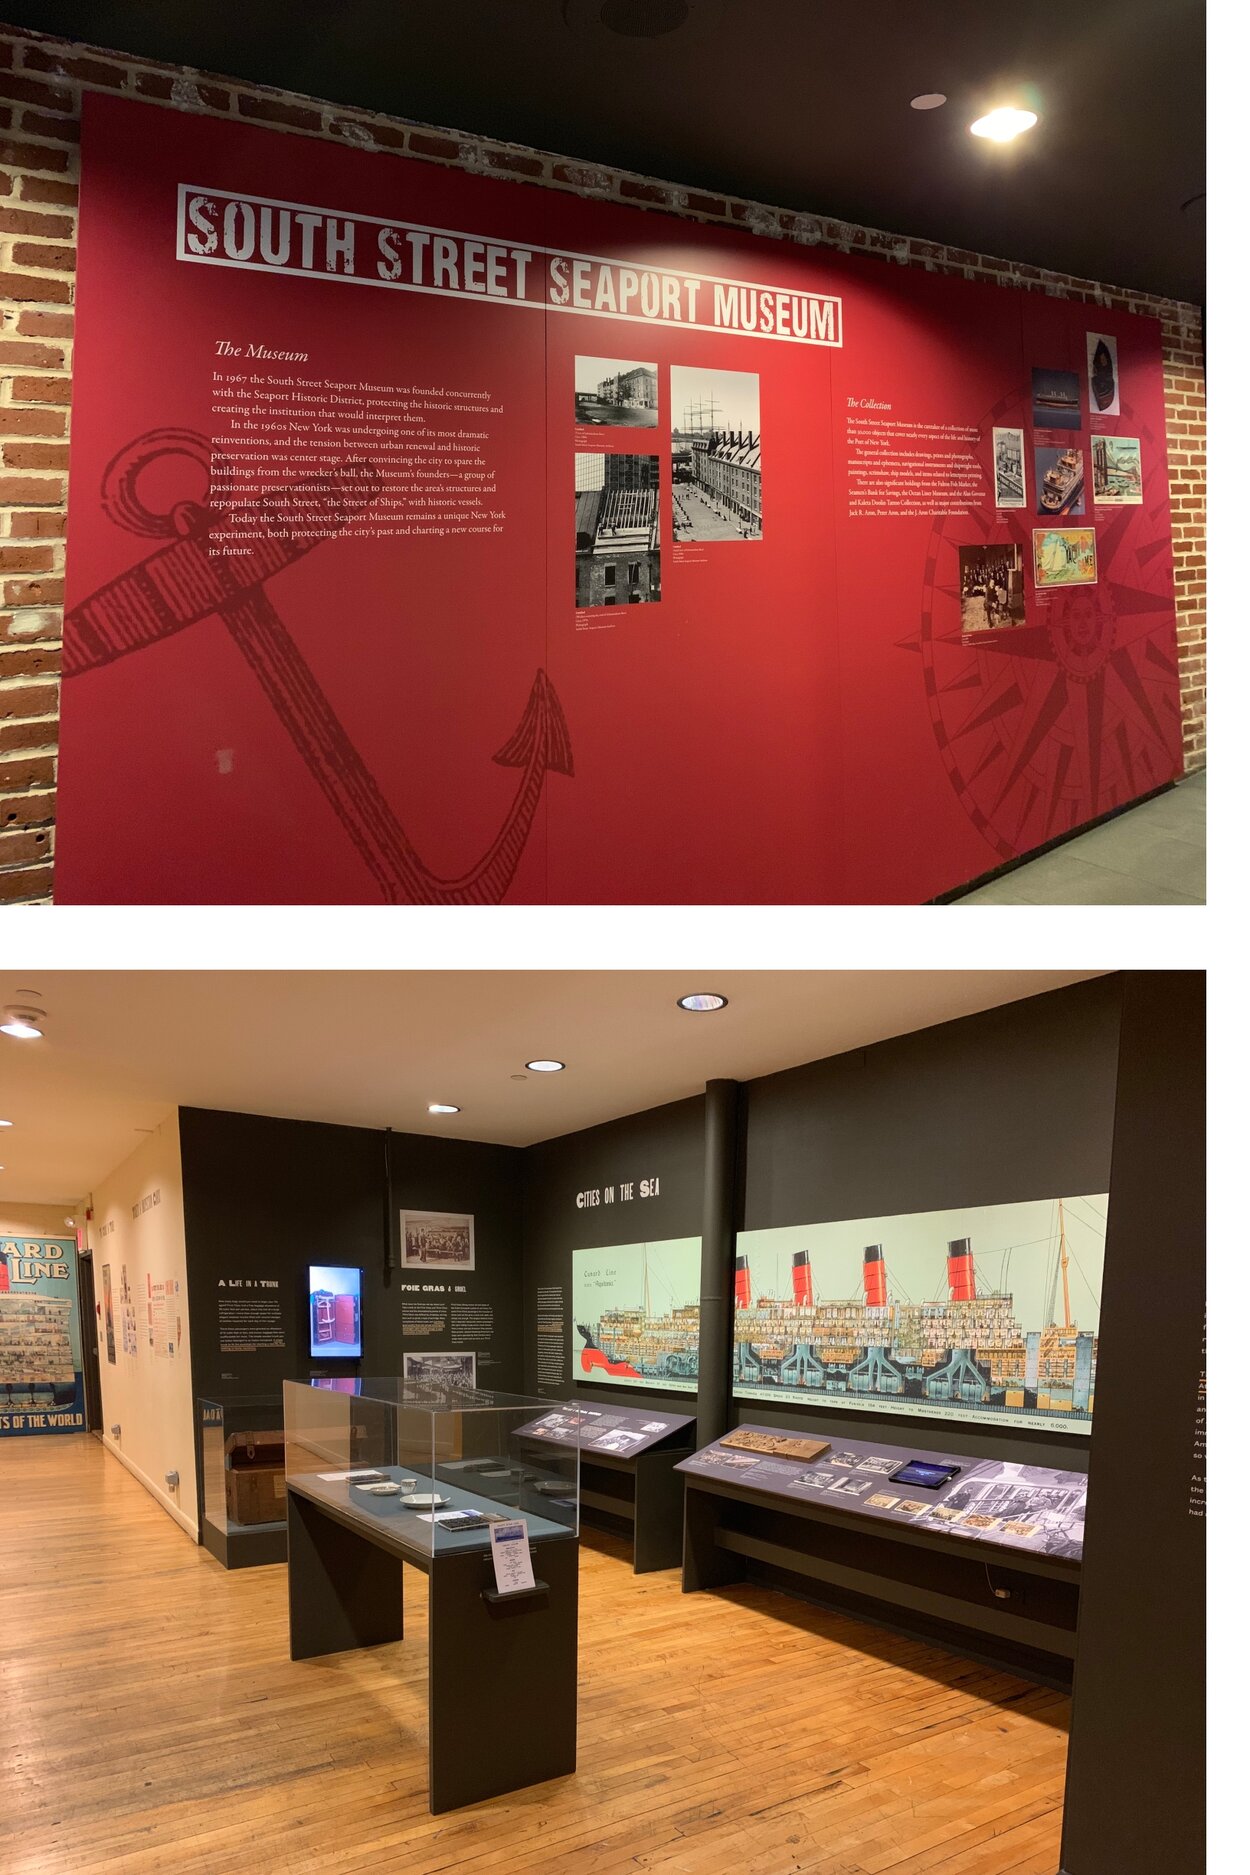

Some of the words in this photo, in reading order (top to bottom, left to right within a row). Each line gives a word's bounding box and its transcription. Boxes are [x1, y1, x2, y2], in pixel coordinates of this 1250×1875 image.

[187, 196, 355, 275] SOUTH
[377, 227, 532, 299] STREET
[549, 257, 701, 323] SEAPORT
[713, 284, 835, 341] MUSEUM
[215, 340, 241, 358] The
[246, 343, 309, 362] Museum
[213, 371, 222, 381] In
[226, 372, 247, 385] 1967
[250, 374, 264, 384] the
[267, 375, 294, 386] South
[297, 377, 322, 387] Street
[324, 379, 356, 392] Seaport
[359, 381, 394, 392] Museum
[412, 385, 444, 395] founded
[446, 388, 491, 400] concurrently
[213, 387, 233, 398] with
[237, 388, 251, 398] the
[254, 390, 288, 403] Seaport
[292, 392, 327, 403] Historic
[367, 396, 408, 409] protecting
[410, 399, 422, 408] the
[424, 400, 452, 409] historic
[454, 402, 489, 411] structures
[490, 404, 503, 412] and
[847, 397, 858, 408] The
[860, 398, 892, 410] Collection
[212, 402, 249, 416] creating
[252, 404, 266, 414] the
[269, 406, 315, 416] institution
[318, 408, 335, 417] that
[338, 409, 363, 419] would
[366, 410, 401, 423] interpret
[231, 419, 240, 428] In
[243, 419, 258, 429] the
[261, 420, 286, 433] 1960s
[289, 421, 309, 431] New
[313, 422, 332, 432] York
[352, 424, 399, 437] undergoing
[417, 427, 426, 436] of
[427, 428, 435, 436] its
[438, 428, 455, 437] most
[458, 429, 489, 438] dramatic
[274, 436, 290, 445] and
[293, 436, 307, 446] the
[310, 437, 341, 447] tension
[343, 438, 378, 448] between
[380, 440, 403, 449] urban
[406, 441, 435, 450] renewal
[437, 442, 451, 450] and
[453, 442, 480, 451] historic
[211, 450, 268, 463] preservation
[290, 452, 317, 462] center
[345, 454, 366, 462] After
[369, 454, 413, 466] convincing
[414, 455, 426, 464] the
[428, 456, 442, 466] city
[444, 456, 452, 464] to
[474, 457, 485, 465] the
[210, 466, 254, 478] buildings
[257, 467, 279, 476] from
[282, 467, 296, 476] the
[360, 468, 373, 477] the
[464, 472, 485, 480] group
[487, 470, 495, 478] of
[210, 482, 258, 494] passionate
[355, 483, 369, 491] out
[371, 483, 380, 491] to
[382, 483, 408, 491] restore
[411, 483, 423, 491] the
[446, 484, 481, 492] structures
[483, 484, 496, 492] and
[210, 497, 260, 509] repopulate
[263, 497, 290, 506] South
[342, 498, 367, 506] Street
[369, 497, 379, 505] of
[408, 497, 426, 505] with
[428, 497, 456, 505] historic
[230, 513, 257, 525] Today
[260, 512, 274, 522] the
[277, 512, 303, 522] South
[306, 512, 331, 521] Street
[334, 512, 366, 523] Seaport
[369, 511, 403, 520] Museum
[406, 511, 436, 520] remains
[444, 511, 469, 521] unique
[490, 510, 506, 518] York
[267, 528, 288, 537] both
[292, 527, 337, 539] protecting
[339, 527, 352, 536] the
[377, 526, 393, 537] past
[396, 526, 410, 534] and
[412, 525, 444, 536] charting
[209, 546, 220, 555] its
[576, 1188, 600, 1209] CITIES
[604, 1185, 615, 1204] ON
[620, 1183, 634, 1201] THE
[640, 1177, 660, 1198] SEA
[11, 1258, 70, 1285] LINE
[422, 1284, 445, 1292] GRAS
[12, 1415, 25, 1429] OF
[27, 1414, 46, 1428] THE
[47, 1413, 83, 1427] WORLD
[1191, 1474, 1202, 1482] As
[1190, 1486, 1204, 1494] the
[1188, 1508, 1203, 1517] had
